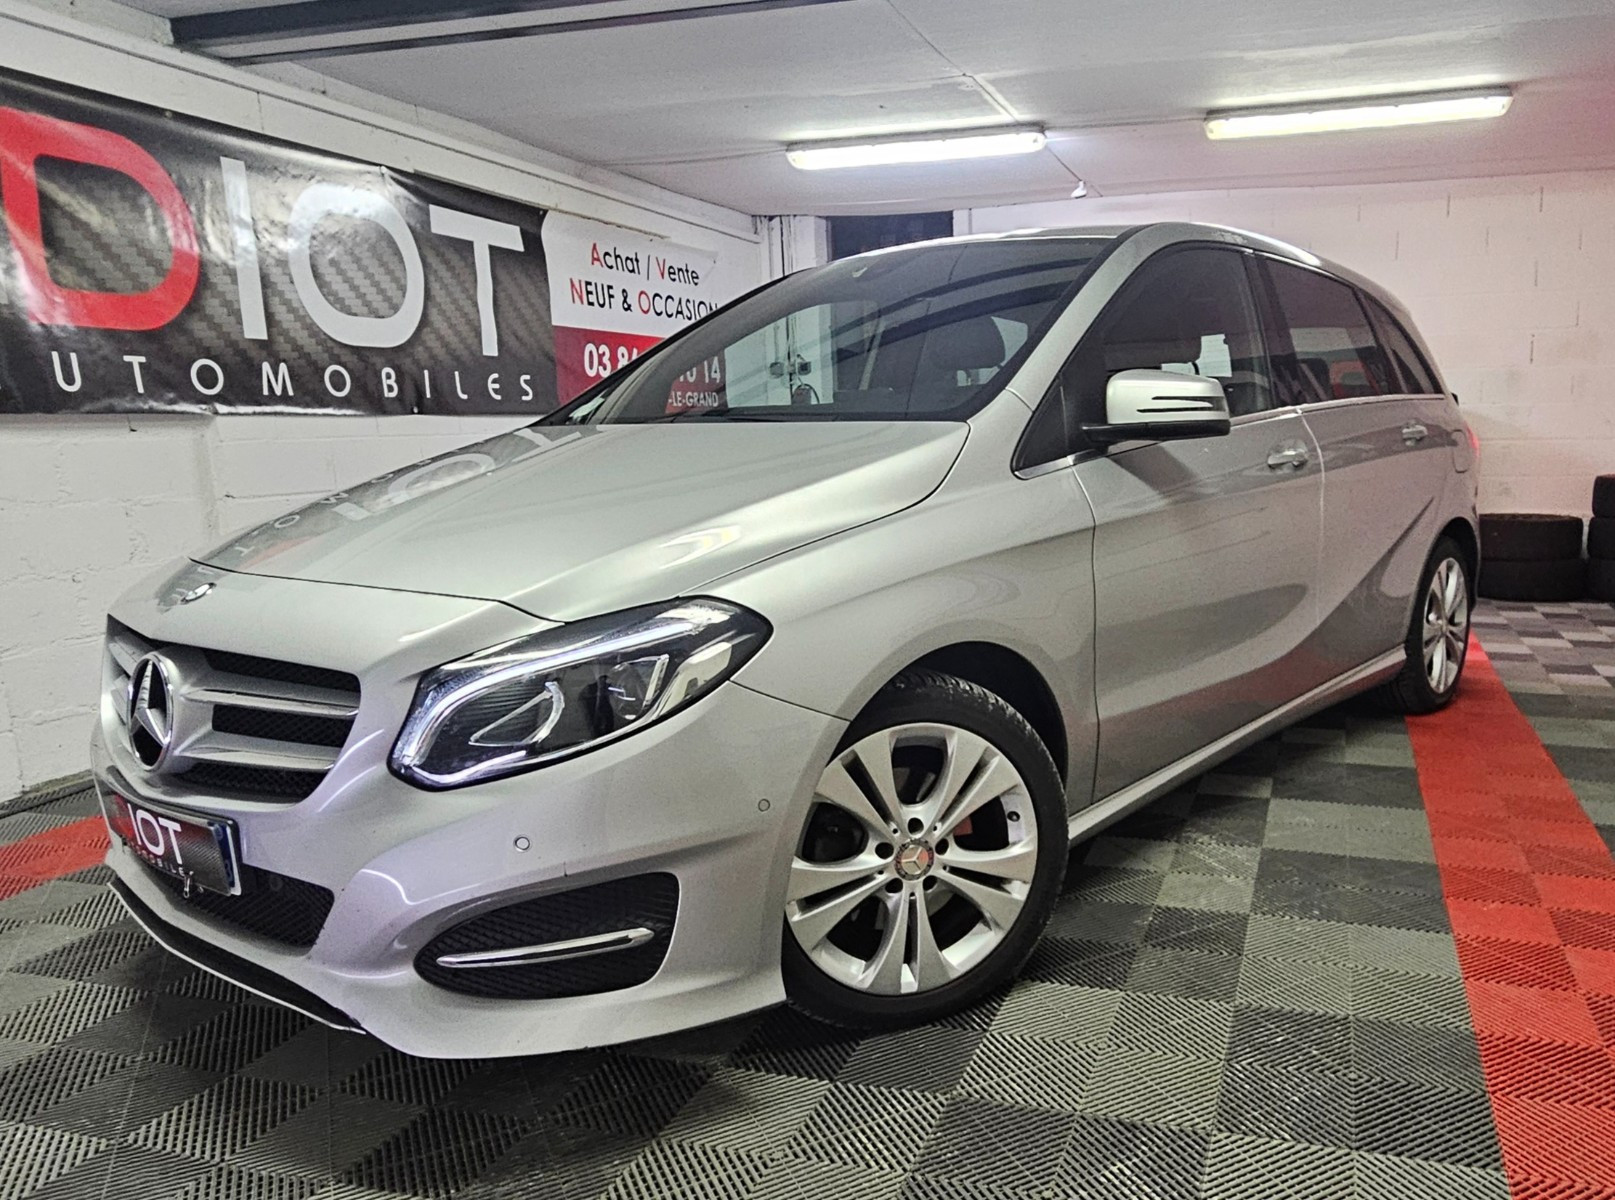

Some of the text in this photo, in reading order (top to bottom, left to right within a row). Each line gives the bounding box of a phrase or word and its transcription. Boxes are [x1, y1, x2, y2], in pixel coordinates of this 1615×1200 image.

[0, 106, 524, 357] DIOT
[591, 242, 641, 275] Achat
[655, 256, 699, 286] Vente
[569, 277, 615, 309] NEUF
[621, 288, 633, 312] &
[51, 350, 533, 401] UTOMOBILES
[583, 342, 612, 377] 03
[703, 355, 721, 384] 14
[668, 390, 719, 407] -LE-GRAND
[126, 802, 182, 865] IOT
